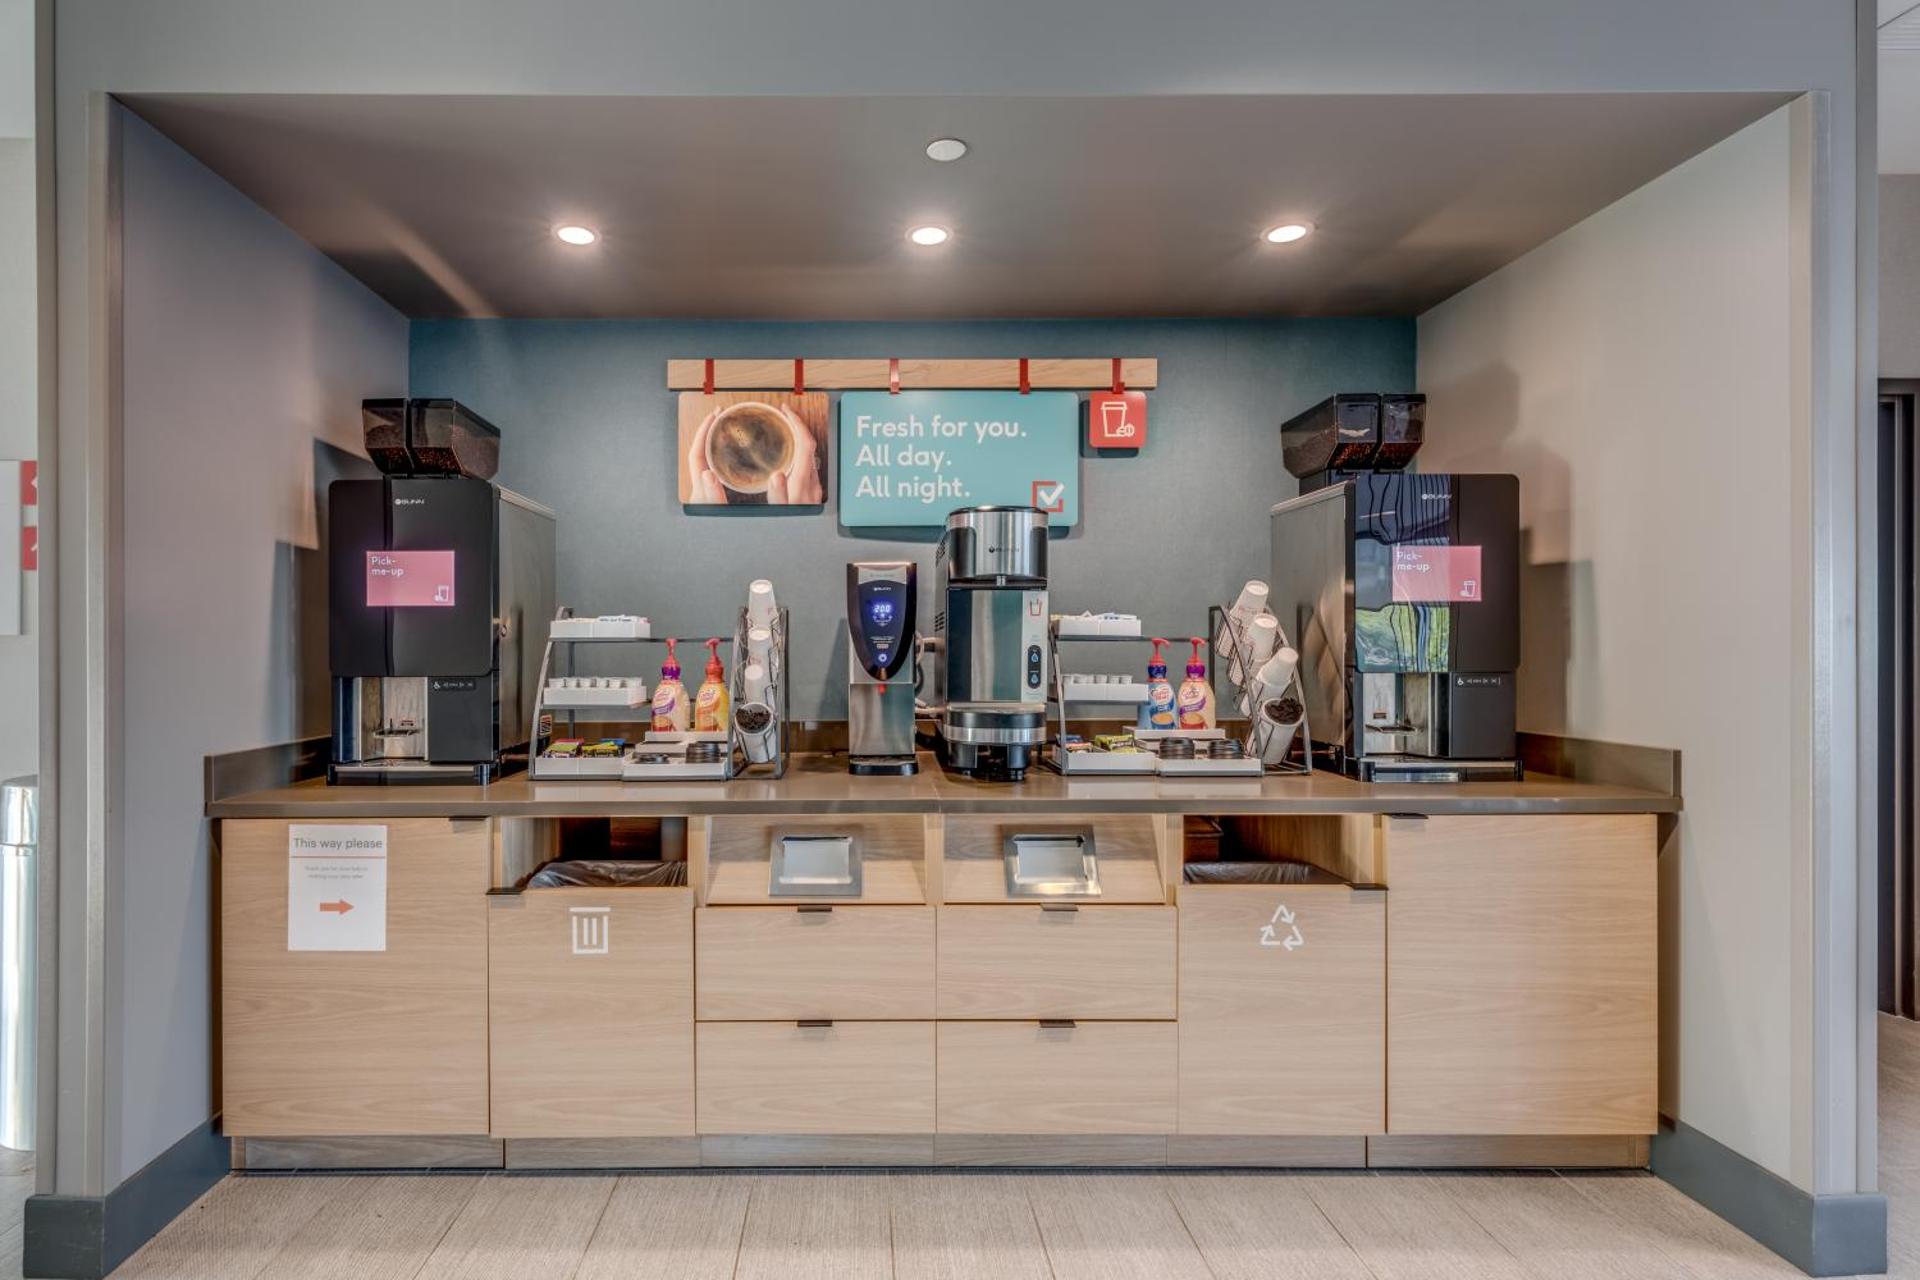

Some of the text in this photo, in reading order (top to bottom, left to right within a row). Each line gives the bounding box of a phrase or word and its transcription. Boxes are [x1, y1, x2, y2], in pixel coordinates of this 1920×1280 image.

[856, 414, 1027, 444] Fresh for you.
[855, 443, 952, 473] All day.
[855, 475, 971, 504] All night.
[371, 556, 396, 566] Pick-
[1396, 551, 1423, 560] Pick-
[371, 568, 404, 577] me-up
[294, 838, 383, 850] This way please
